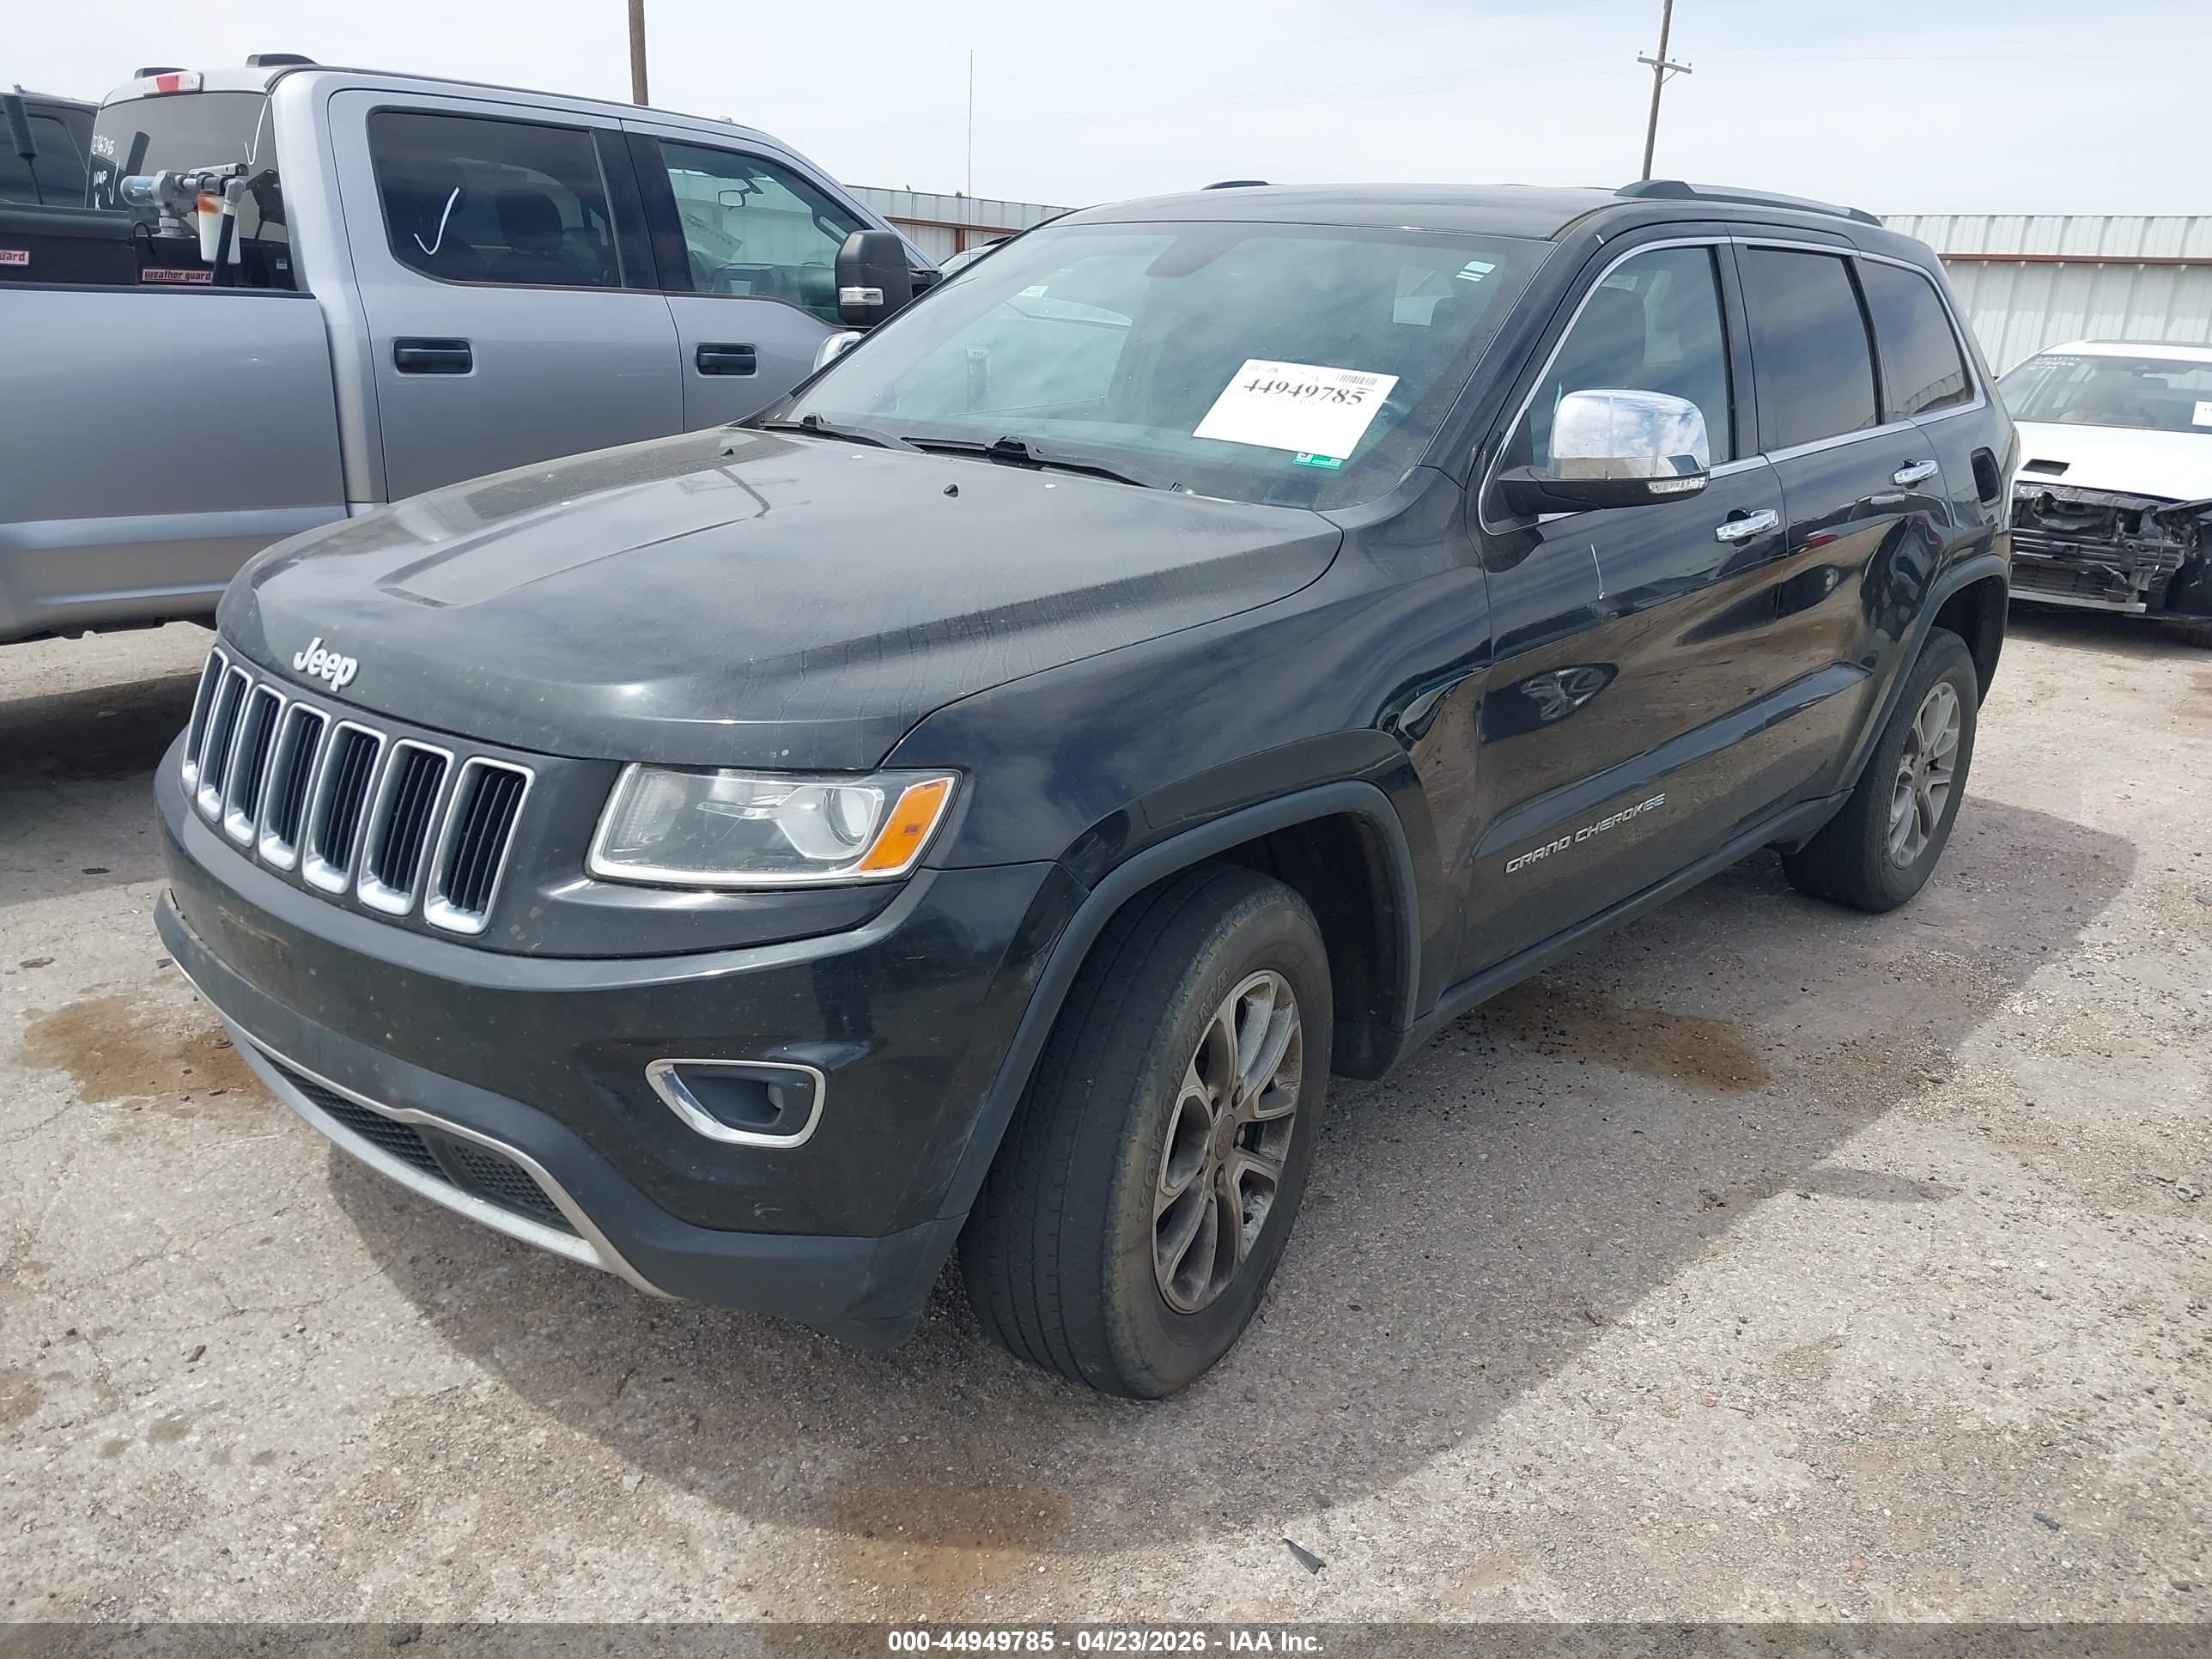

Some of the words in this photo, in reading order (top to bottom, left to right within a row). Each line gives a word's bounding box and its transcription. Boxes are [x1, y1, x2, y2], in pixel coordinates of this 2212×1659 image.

[144, 270, 182, 279] weather
[185, 272, 212, 281] guard
[1243, 378, 1366, 405] 44949785
[293, 636, 358, 692] Jeep
[1504, 836, 1571, 874] GRAND
[1574, 793, 1666, 843] CHEROKEE
